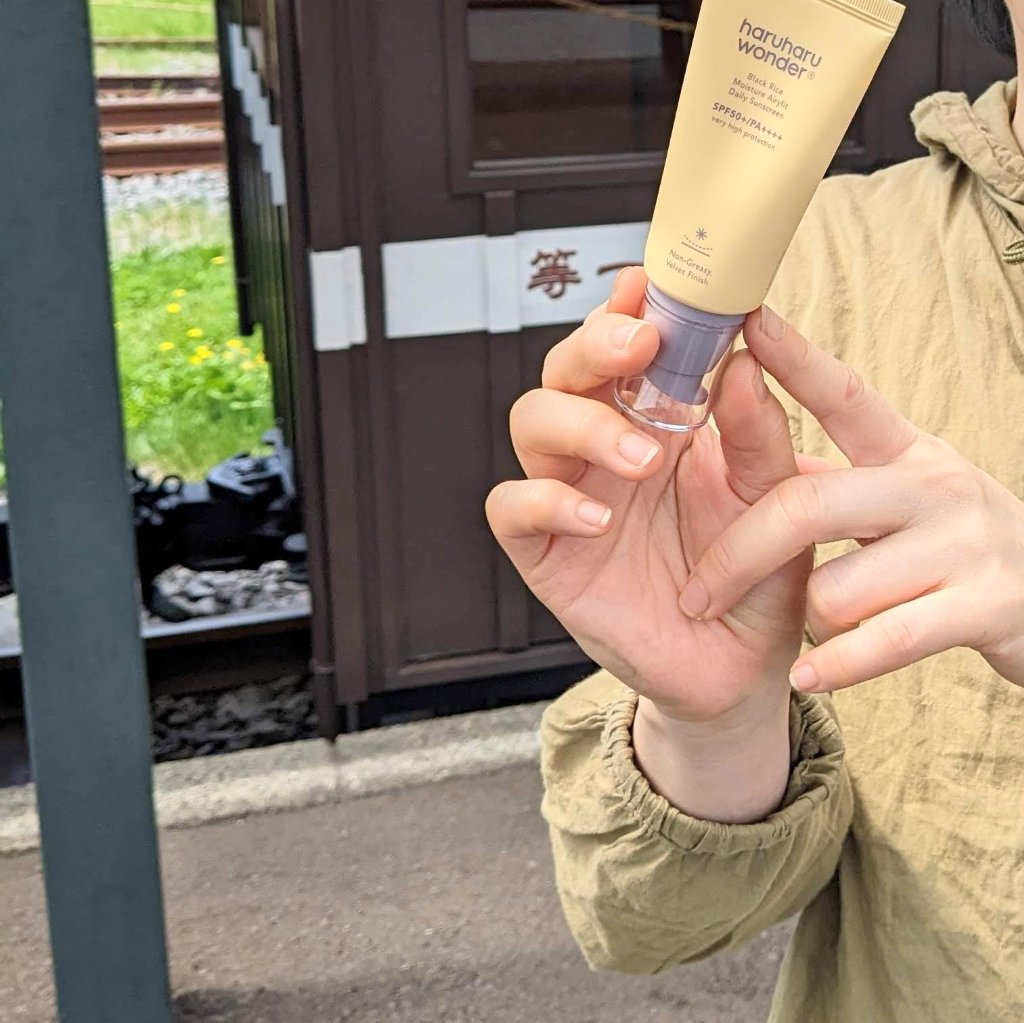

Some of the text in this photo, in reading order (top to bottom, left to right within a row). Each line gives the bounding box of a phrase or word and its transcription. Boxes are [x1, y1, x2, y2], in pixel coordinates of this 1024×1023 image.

[738, 17, 823, 68] haruharu
[732, 77, 789, 111] Moisture Airyfit
[747, 72, 784, 95] Black Rice
[728, 87, 785, 120] Daily Sunscreen
[711, 116, 776, 151] very high protection
[666, 257, 709, 287] Velvet Finish
